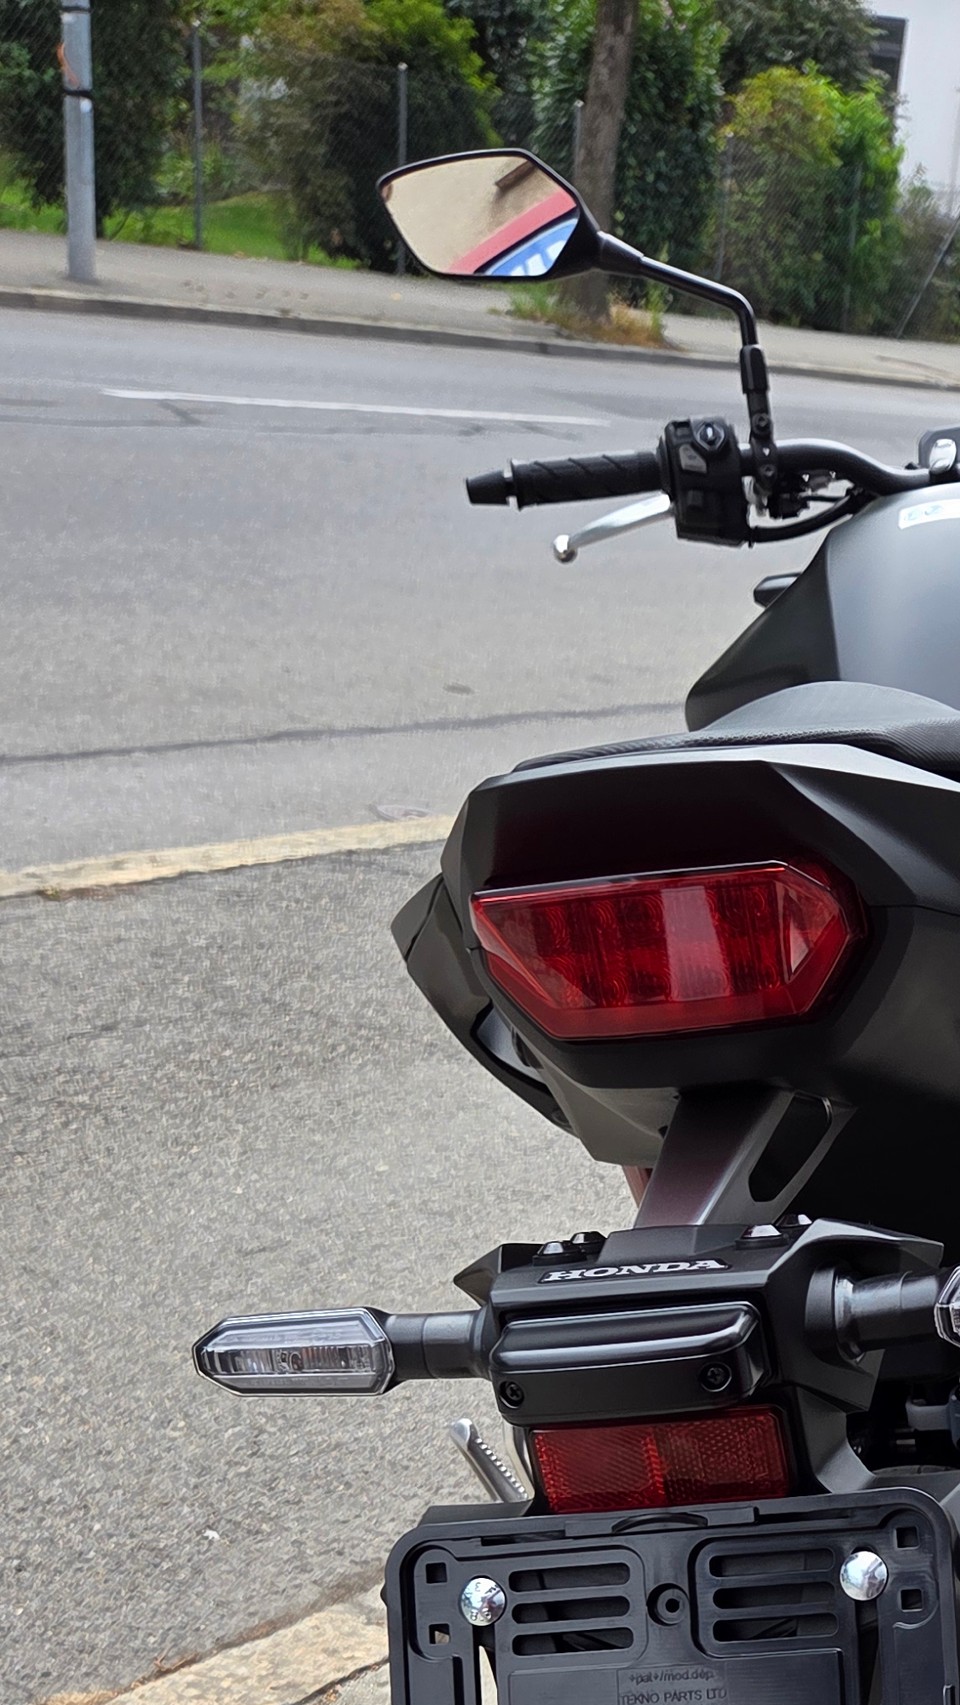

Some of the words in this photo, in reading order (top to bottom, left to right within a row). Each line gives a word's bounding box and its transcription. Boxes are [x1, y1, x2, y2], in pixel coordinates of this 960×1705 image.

[543, 1260, 728, 1282] HONDA
[621, 1691, 660, 1705] TEKNO
[664, 1690, 702, 1703] PARTS
[706, 1687, 727, 1700] LTD
